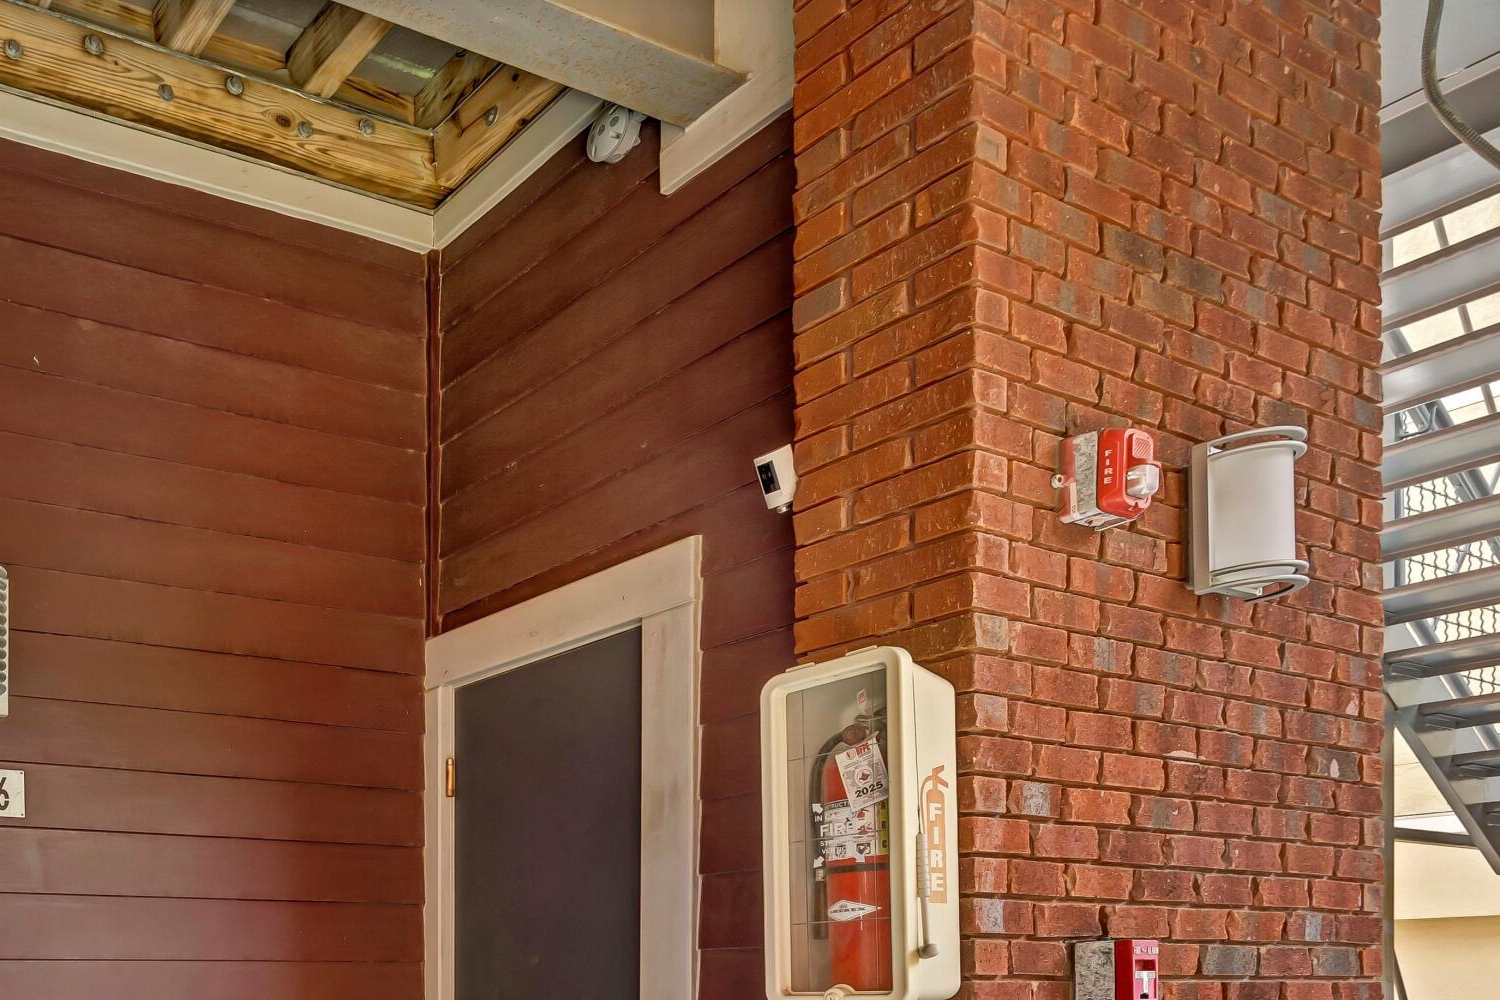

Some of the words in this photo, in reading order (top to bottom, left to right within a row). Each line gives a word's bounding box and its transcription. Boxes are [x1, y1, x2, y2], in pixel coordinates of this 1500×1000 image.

[1103, 449, 1113, 485] FIRE
[855, 780, 884, 798] 2025
[929, 802, 945, 892] FIRE
